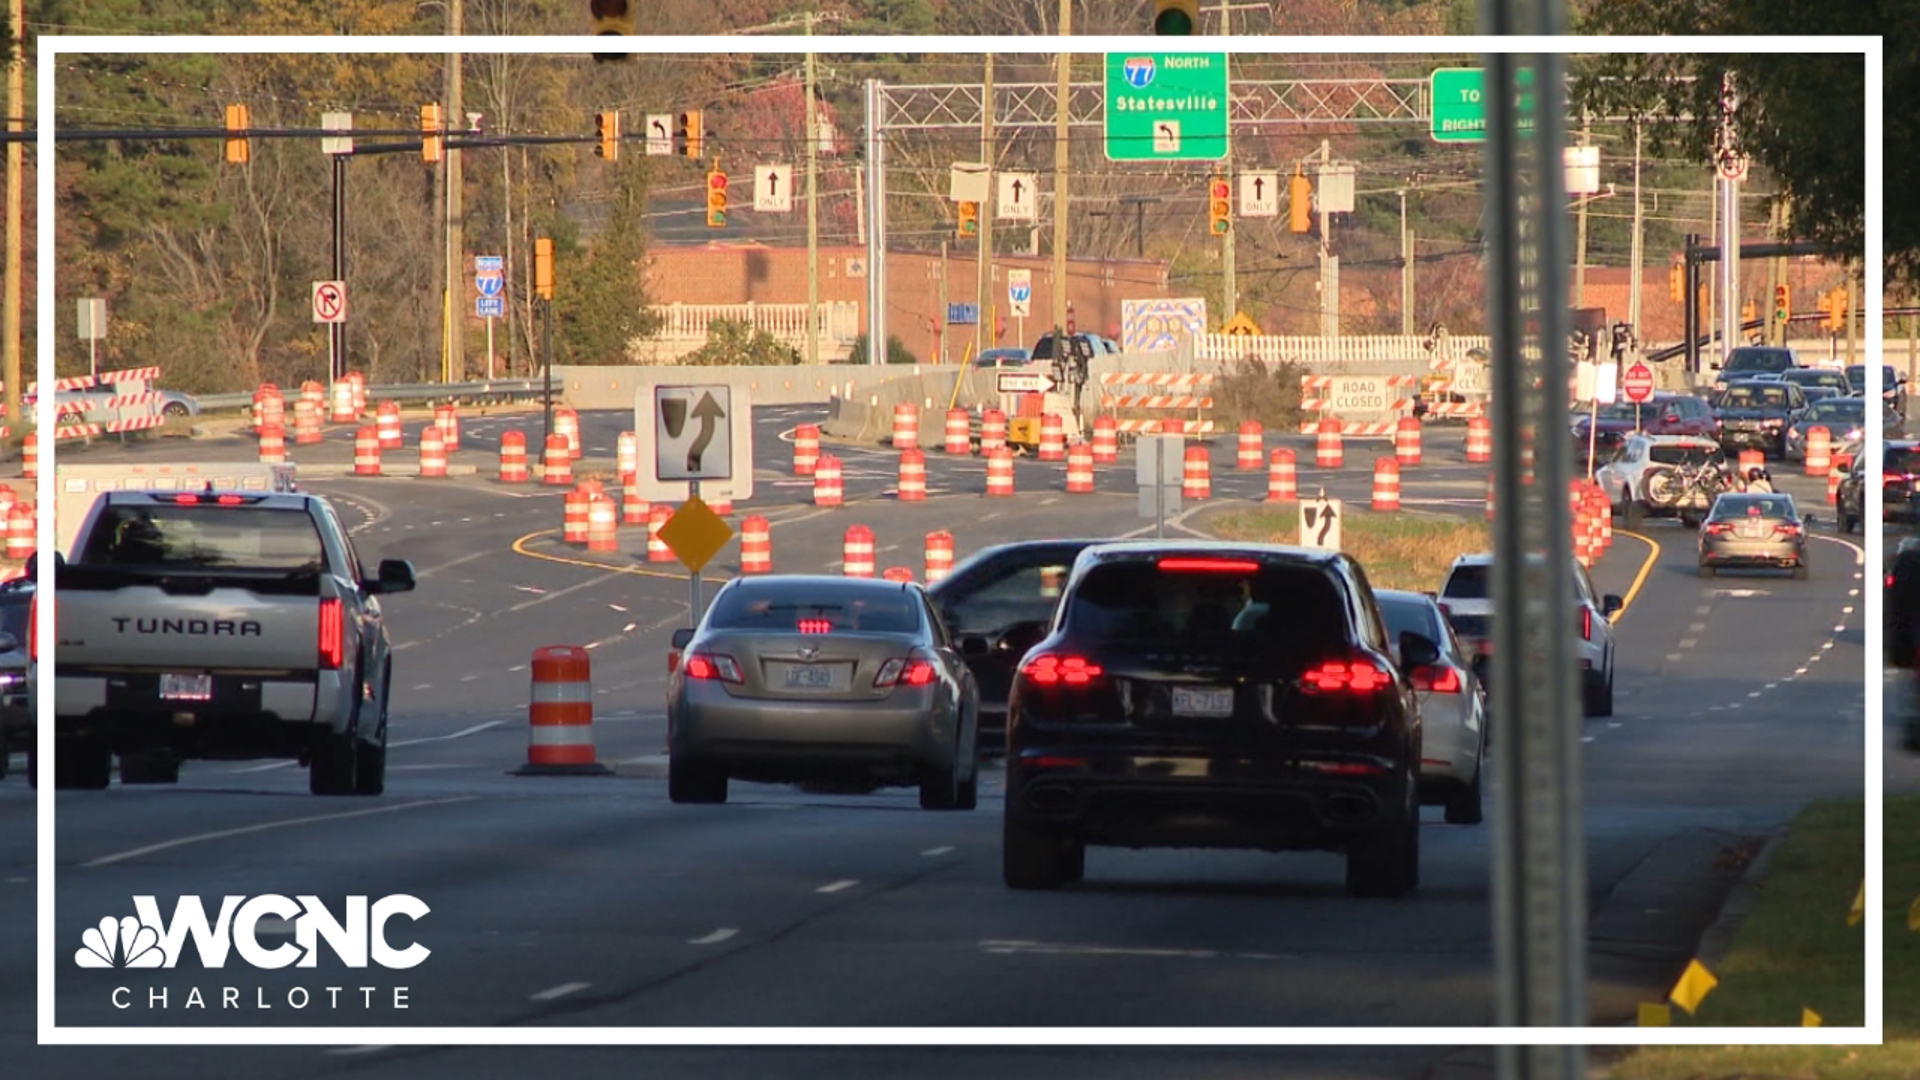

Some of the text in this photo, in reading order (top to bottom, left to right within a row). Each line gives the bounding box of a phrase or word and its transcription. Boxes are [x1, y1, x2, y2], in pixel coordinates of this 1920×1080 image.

[1128, 56, 1210, 82] 77 NORTH
[1460, 89, 1480, 102] TO
[1116, 96, 1218, 110] Statesville
[759, 198, 785, 207] ONLY
[1003, 204, 1030, 214] ONLY
[1245, 202, 1272, 212] ONLY
[479, 277, 500, 291] 77
[1343, 382, 1375, 393] ROAD
[1336, 395, 1382, 408] CLOSED
[112, 617, 262, 636] TUNDRA
